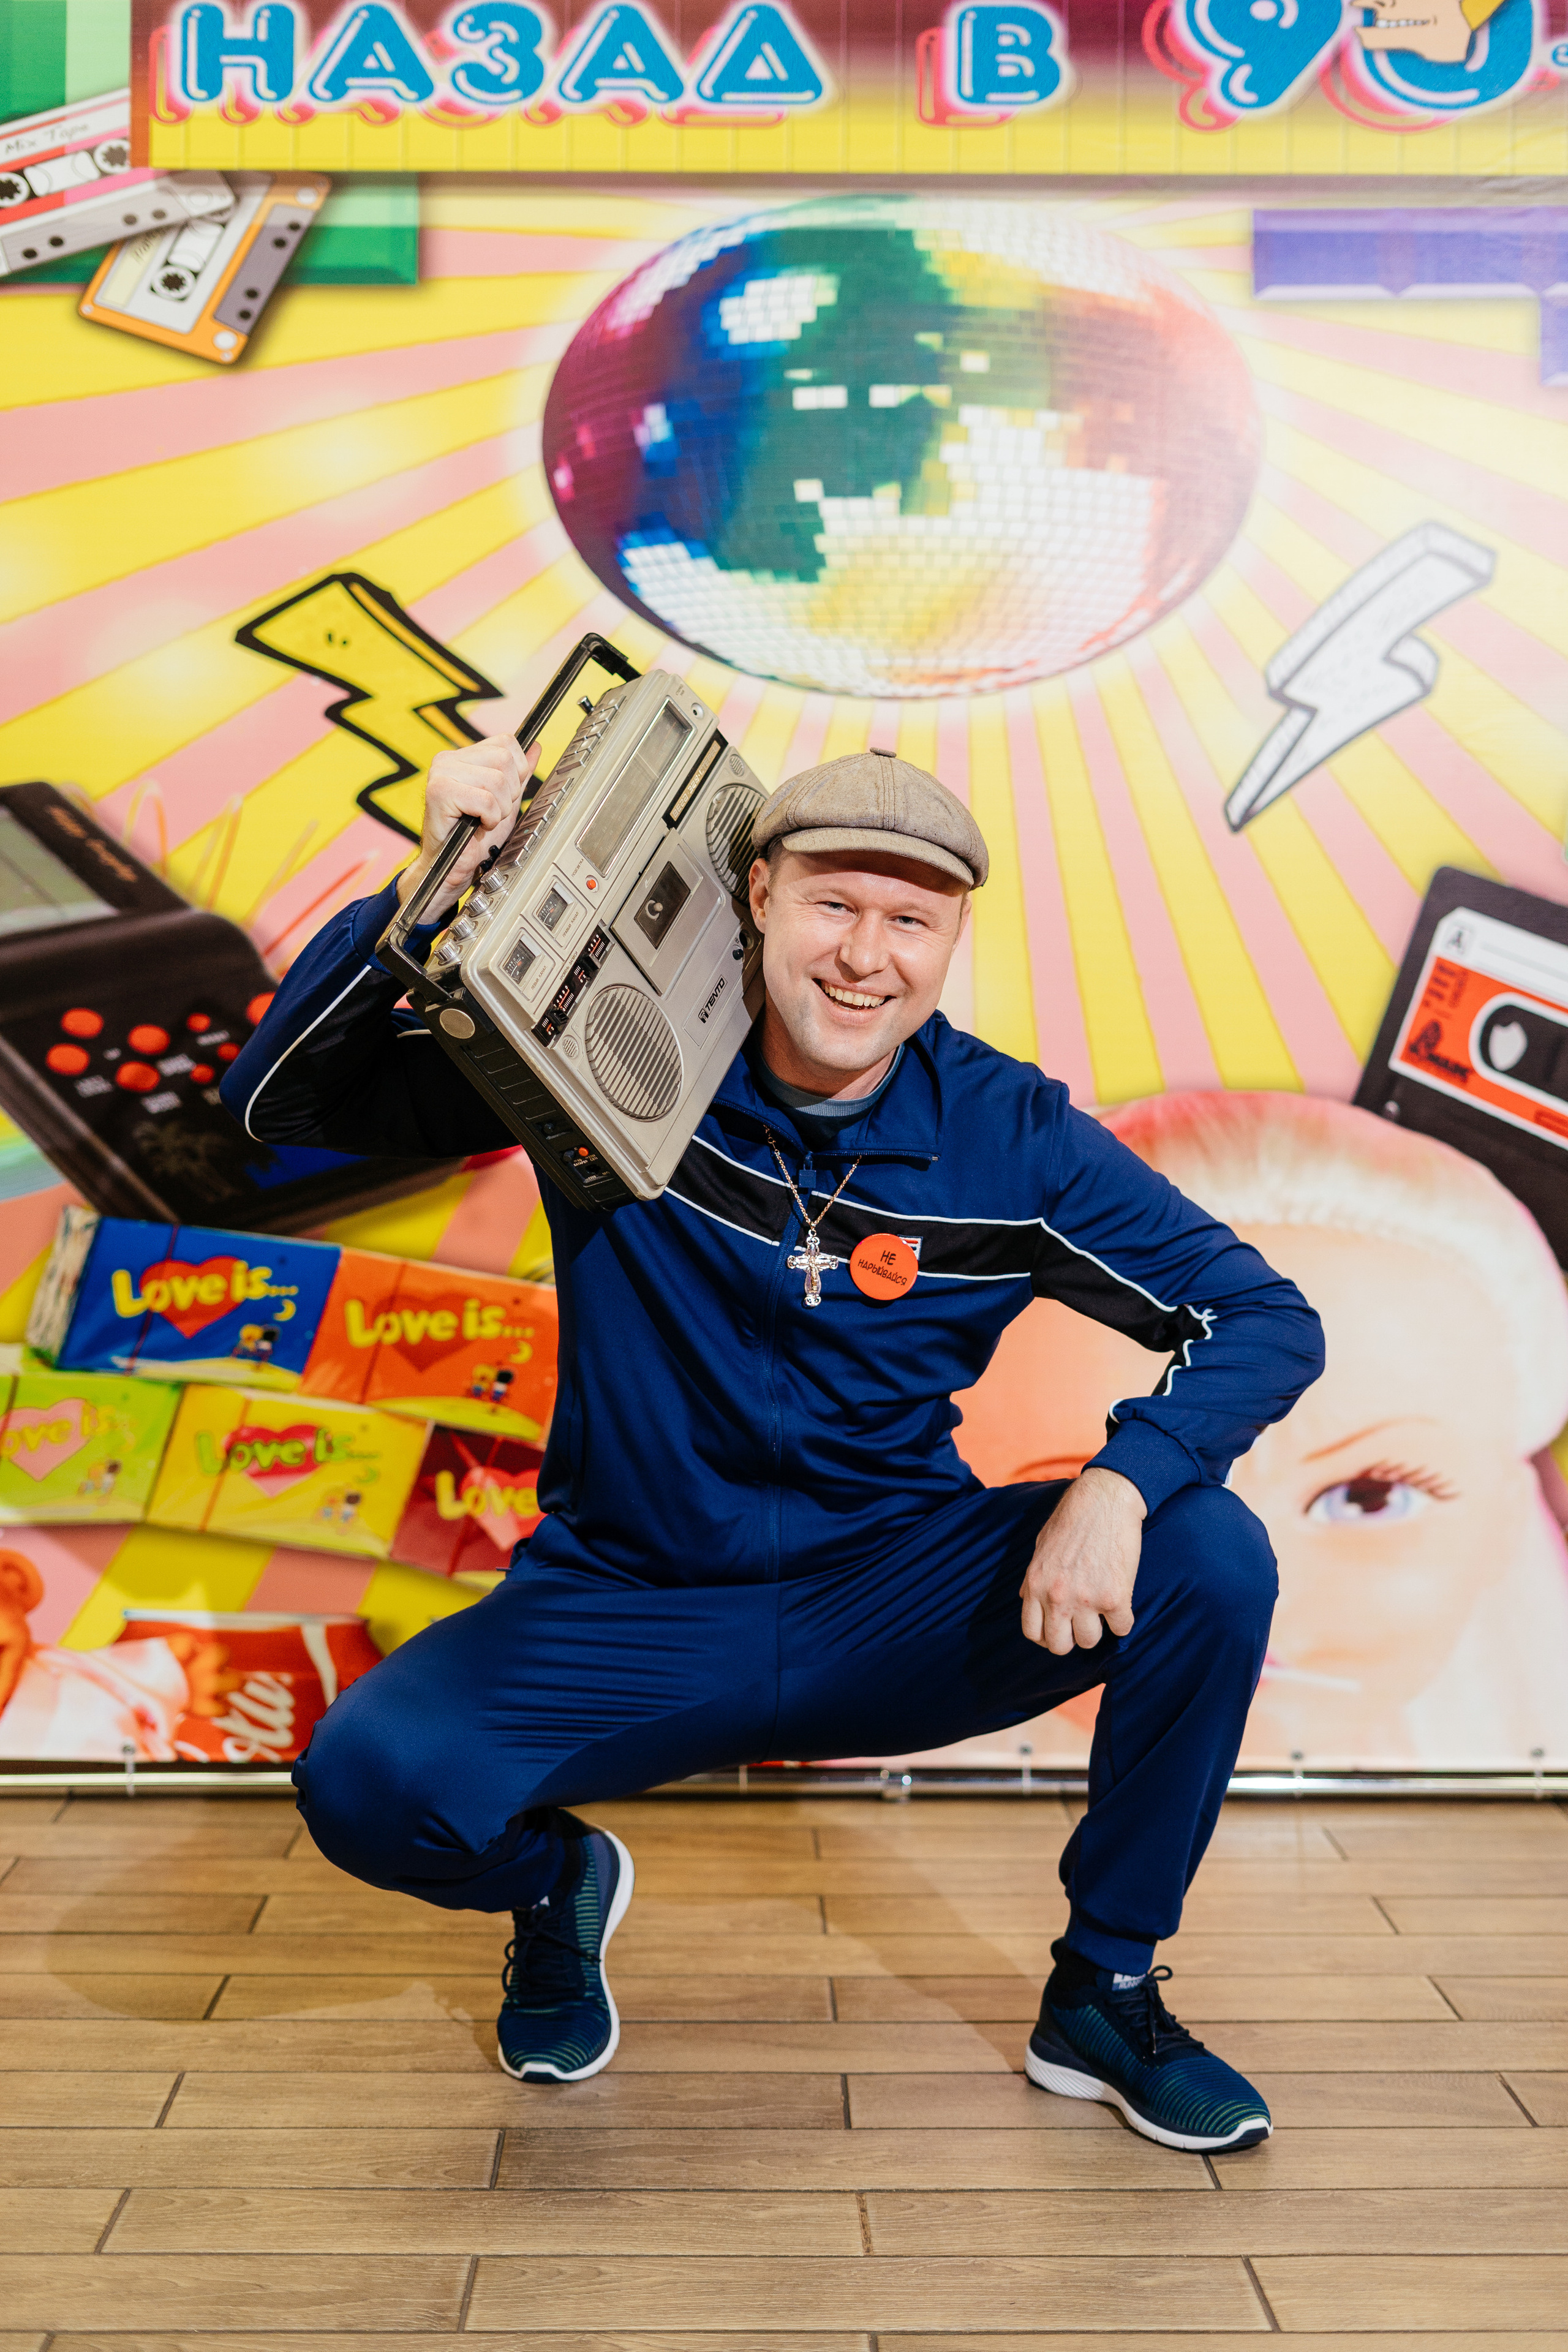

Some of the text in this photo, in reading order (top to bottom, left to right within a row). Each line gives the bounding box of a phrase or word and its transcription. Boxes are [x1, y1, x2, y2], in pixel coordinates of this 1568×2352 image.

[176, 2, 827, 105] НАЗАД
[954, 3, 1065, 107] В
[571, 858, 584, 877] ПОДСВЕТКА
[570, 911, 579, 924] КАНАЛ
[538, 965, 546, 978] КАНАЛ
[559, 951, 578, 981] УРОВЕНЬ ЗАПИСИ
[705, 978, 725, 1011] TENTO
[880, 1250, 896, 1265] НЕ
[111, 1268, 228, 1317] Love
[344, 1298, 459, 1349] Love
[0, 1418, 72, 1457] ove
[194, 1430, 306, 1476] Love
[435, 1469, 538, 1521] Love
